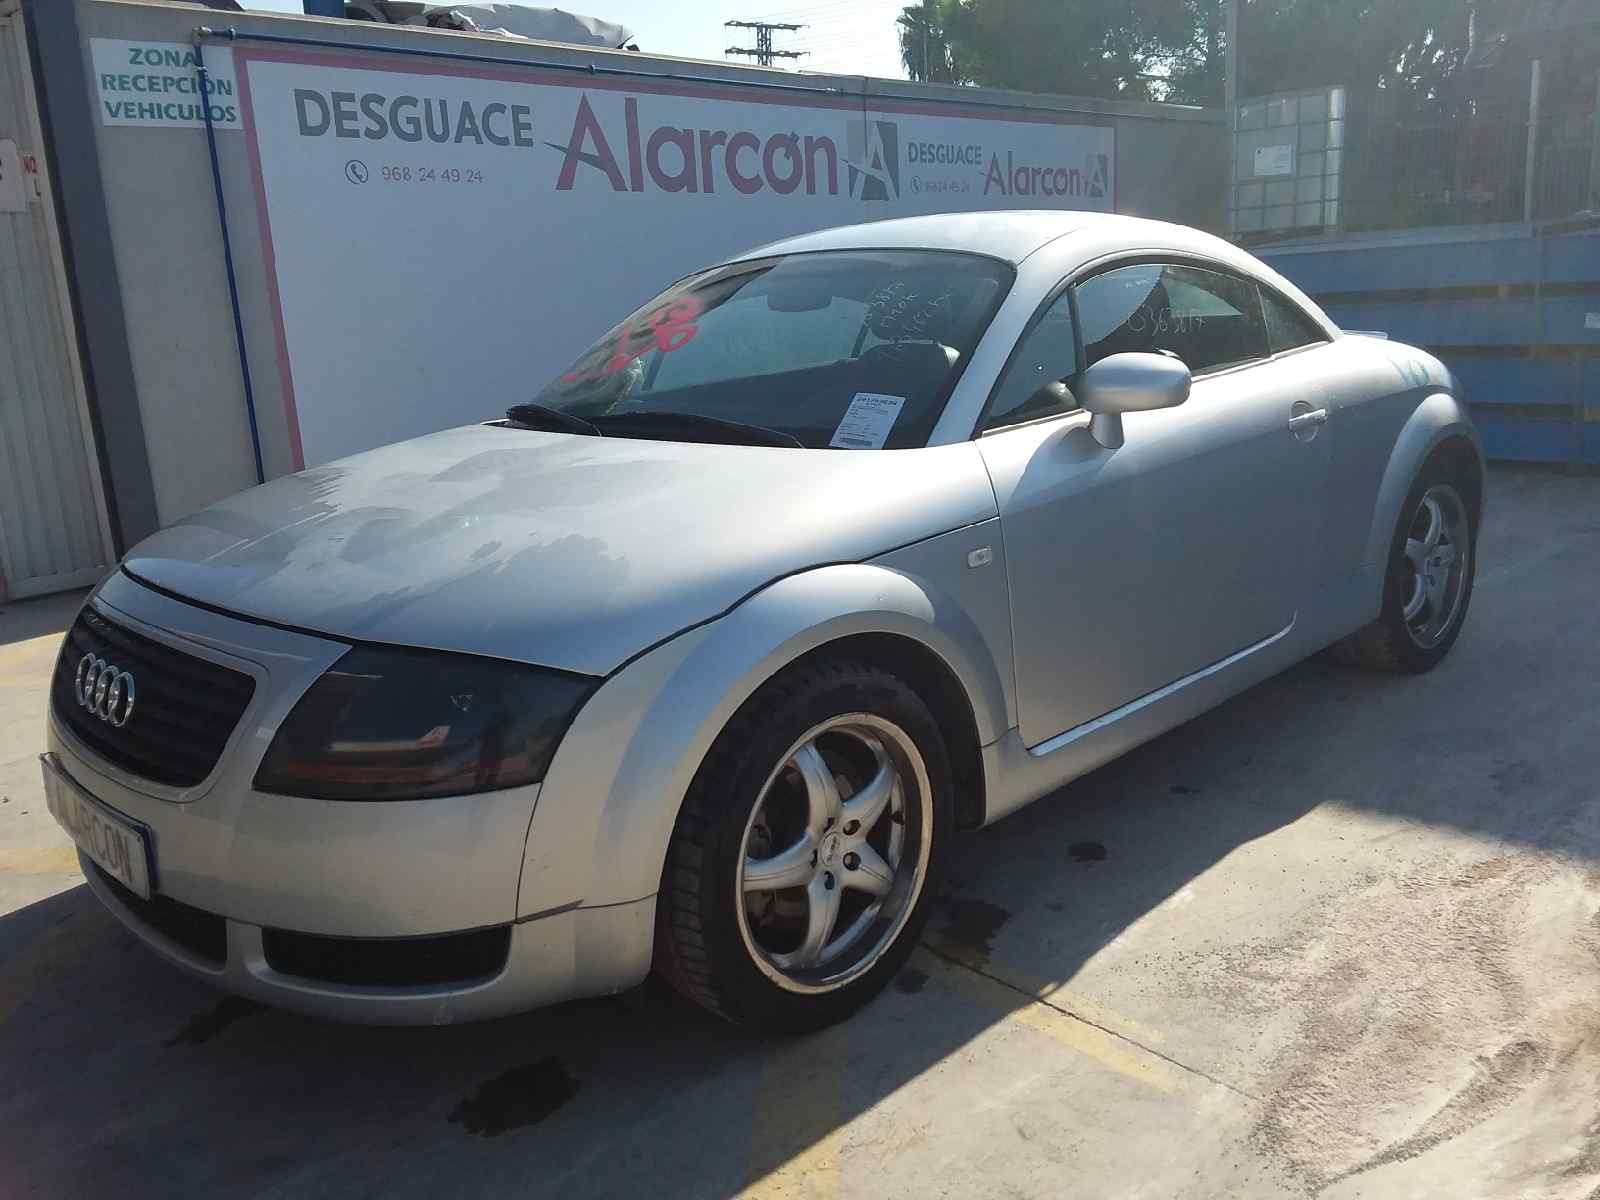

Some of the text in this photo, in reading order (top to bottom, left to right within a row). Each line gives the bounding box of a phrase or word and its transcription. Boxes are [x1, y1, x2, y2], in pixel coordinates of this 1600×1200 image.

[128, 47, 197, 67] ZONA
[294, 88, 534, 147] DESGUACE
[907, 142, 982, 165] DESGUACE
[382, 166, 485, 184] 968 24 49 24
